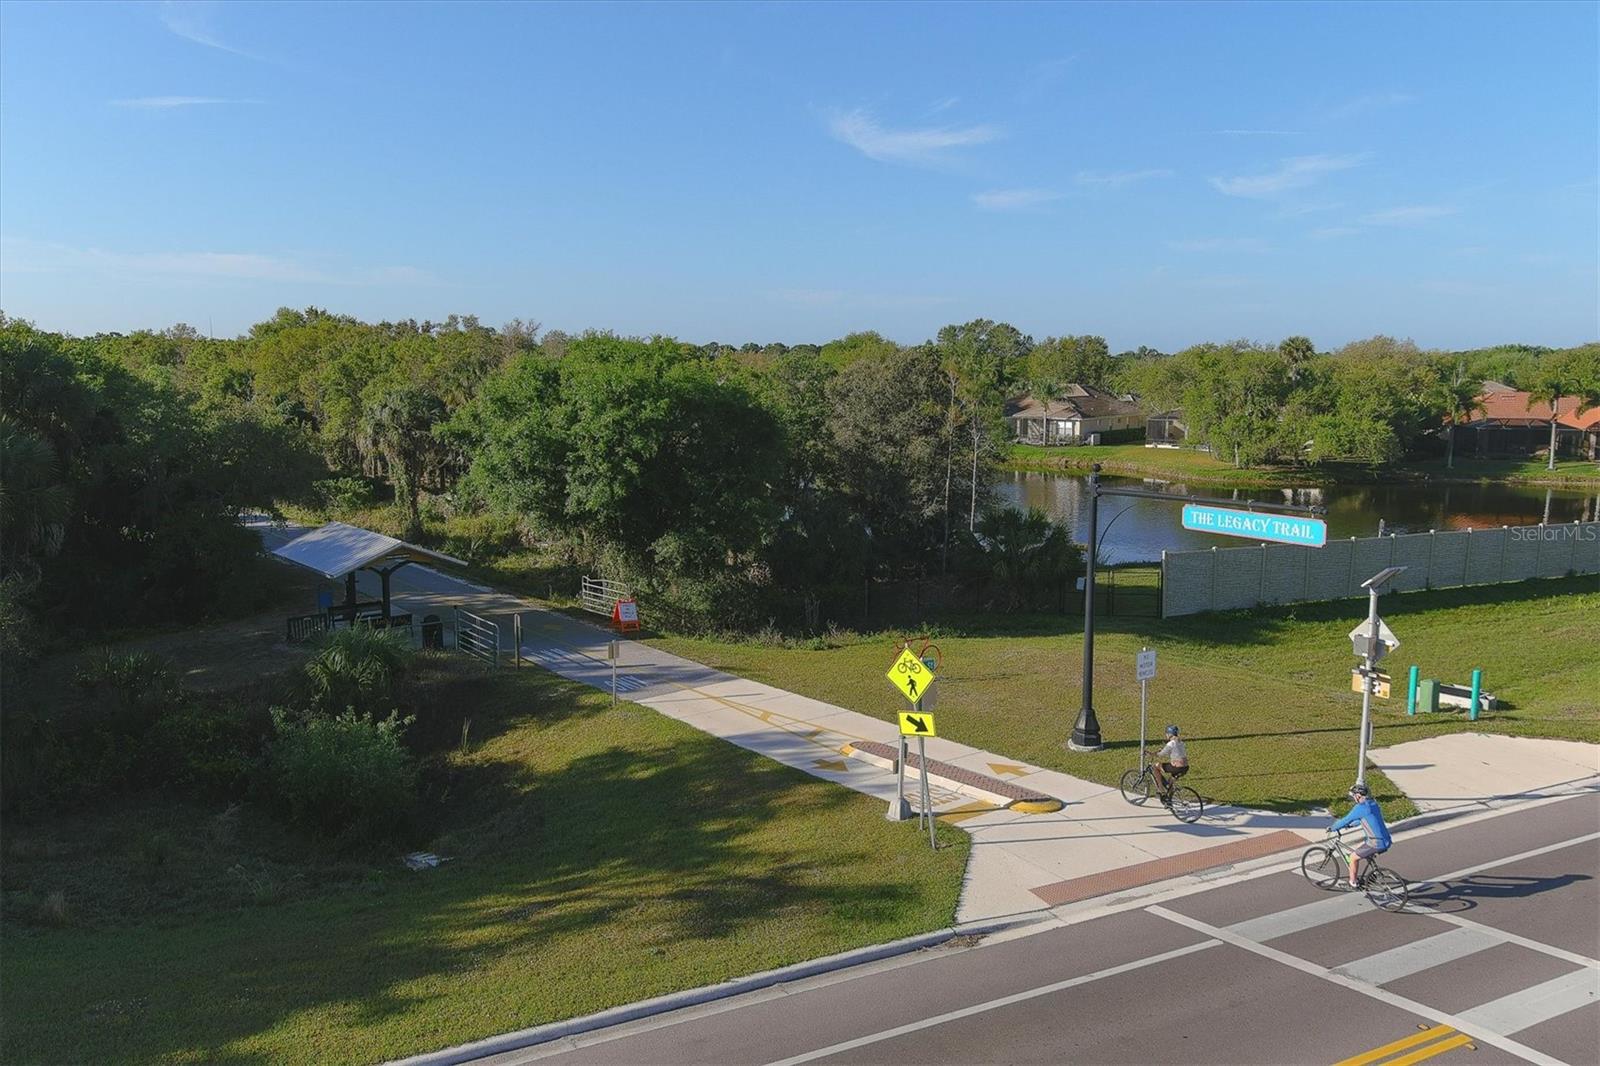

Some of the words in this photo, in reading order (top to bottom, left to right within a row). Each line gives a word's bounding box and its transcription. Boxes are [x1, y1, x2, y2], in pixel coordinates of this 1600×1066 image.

[1191, 511, 1214, 526] THE
[1218, 514, 1271, 534] LEGACY
[1272, 521, 1315, 539] TRAIL
